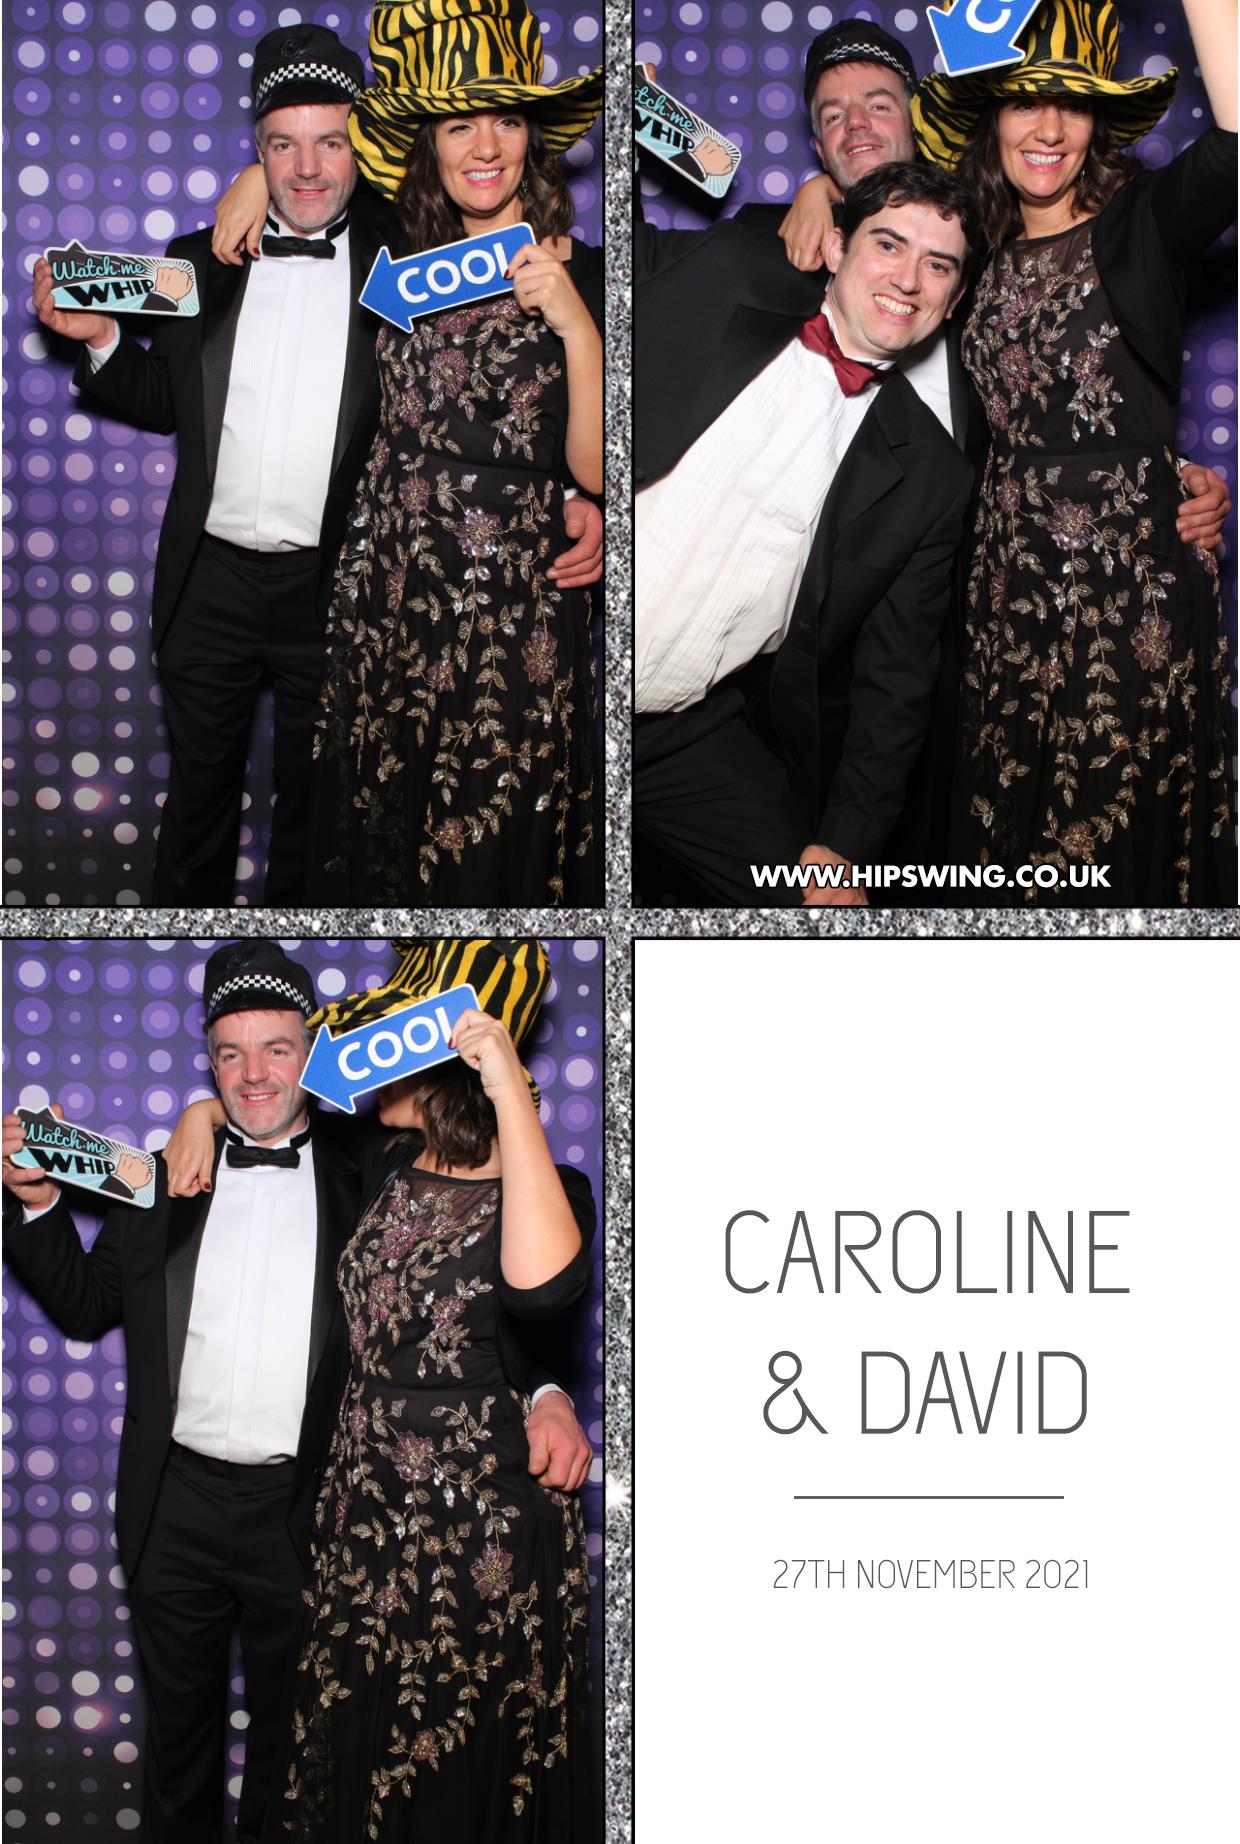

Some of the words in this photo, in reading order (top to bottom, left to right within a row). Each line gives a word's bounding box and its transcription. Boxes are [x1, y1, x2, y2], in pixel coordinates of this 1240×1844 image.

[635, 86, 666, 116] tch
[670, 110, 696, 133] me
[52, 256, 117, 281] Watch
[120, 262, 146, 275] me
[62, 279, 154, 307] WHIP
[27, 1146, 115, 1175] WHIP
[86, 1141, 111, 1155] me
